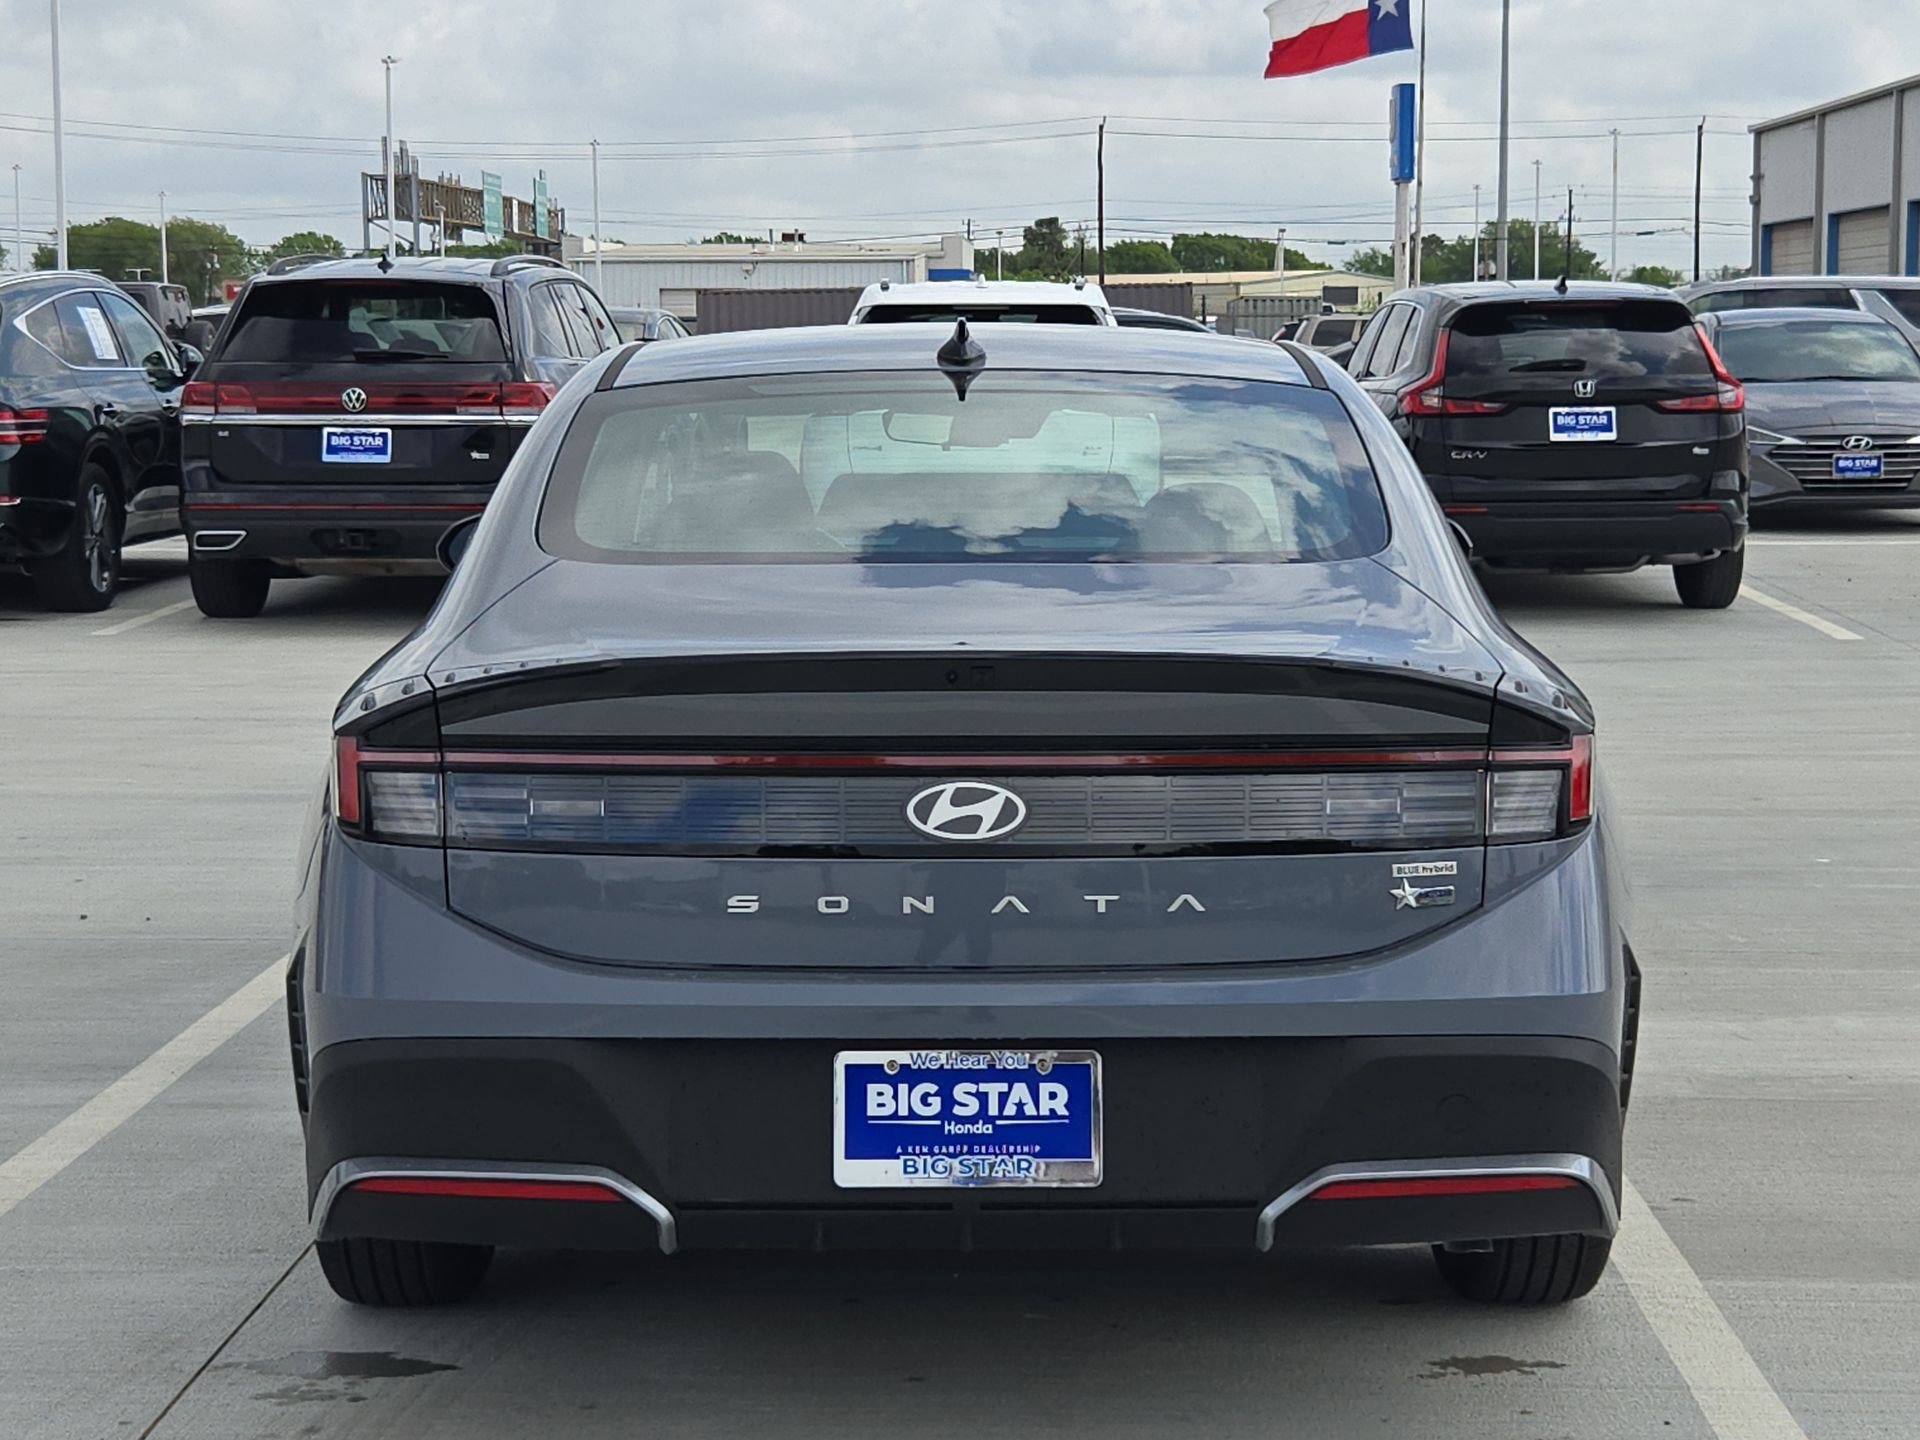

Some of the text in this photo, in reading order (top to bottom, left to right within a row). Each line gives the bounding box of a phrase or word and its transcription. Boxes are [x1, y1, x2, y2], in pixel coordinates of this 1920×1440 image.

[1557, 415, 1607, 425] BIG STAR
[331, 435, 383, 446] BIG STAR
[726, 894, 1206, 914] SONATA
[911, 1051, 1028, 1067] We Hear You
[866, 1082, 1069, 1116] BIG STAR
[944, 1120, 993, 1135] Honda
[902, 1158, 1033, 1175] BIG STAR
